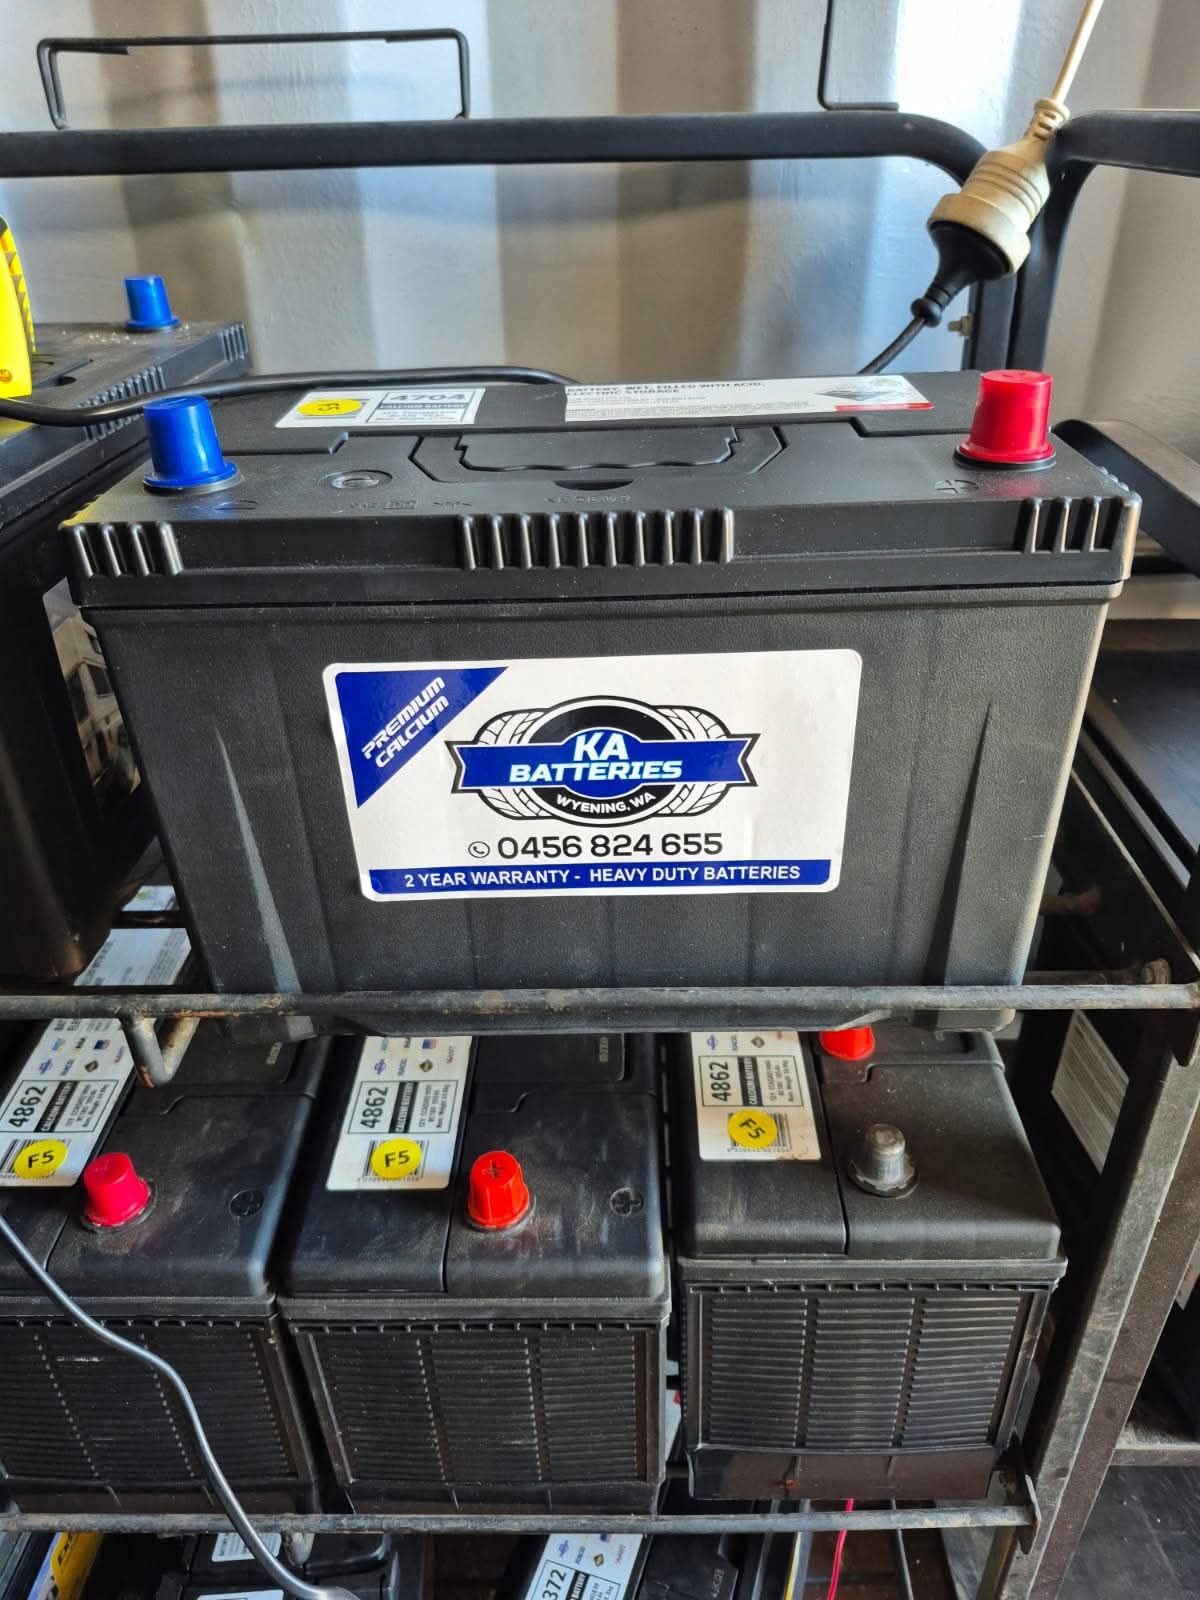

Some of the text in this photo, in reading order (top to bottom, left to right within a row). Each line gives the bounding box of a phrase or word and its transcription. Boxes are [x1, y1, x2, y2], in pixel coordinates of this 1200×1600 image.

[361, 676, 446, 760] PREMIUM
[375, 695, 449, 768] CALCIUM
[573, 731, 629, 762] KA
[509, 760, 683, 783] BATTERIES
[556, 791, 656, 814] WYENING, WA
[497, 832, 723, 859] 0456 824 655
[404, 874, 415, 887] 2
[418, 872, 467, 887] YEAR
[471, 869, 570, 885] WARRANTY
[589, 867, 648, 882] HEAVY
[652, 866, 699, 881] DUTY
[703, 865, 800, 880] BATTERIES
[709, 1061, 732, 1102] 4862
[9, 1086, 48, 1128] 4862
[360, 1087, 388, 1129] 4862
[739, 1117, 766, 1139] F5
[28, 1151, 54, 1168] F5
[384, 1150, 410, 1168] F5
